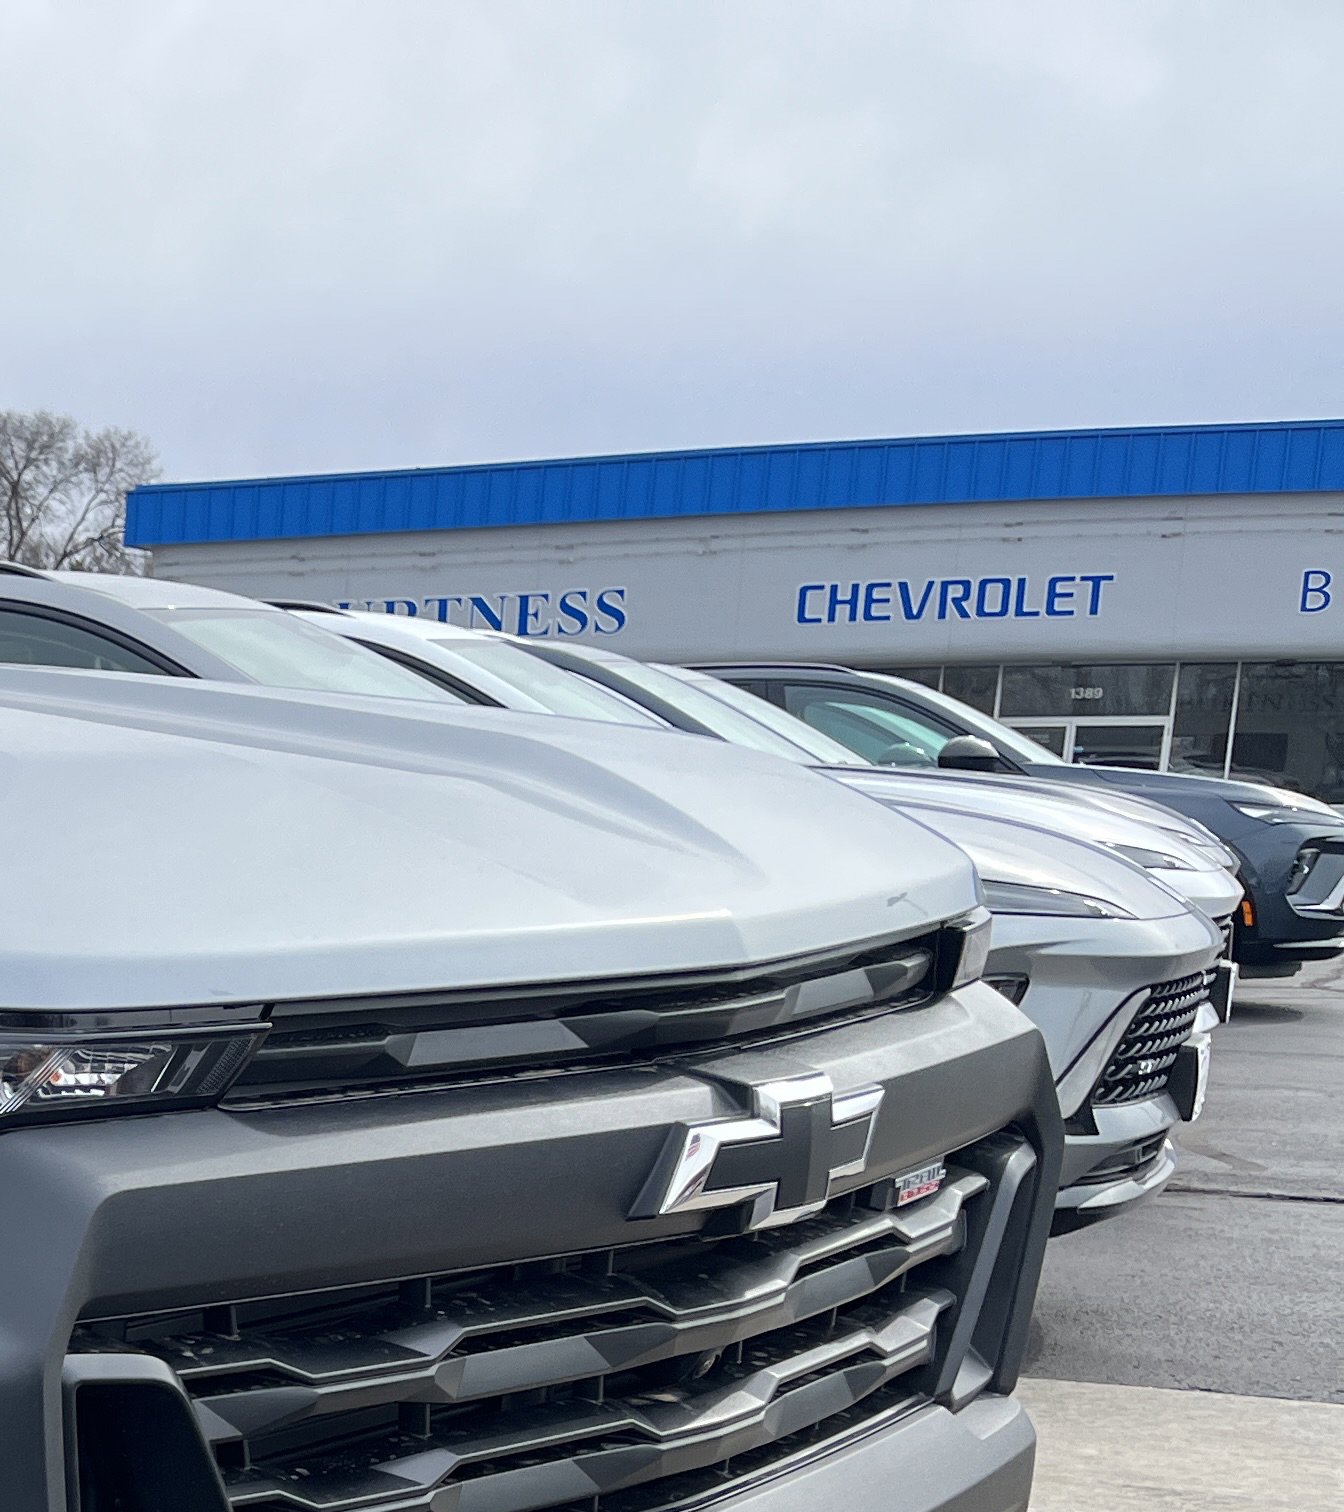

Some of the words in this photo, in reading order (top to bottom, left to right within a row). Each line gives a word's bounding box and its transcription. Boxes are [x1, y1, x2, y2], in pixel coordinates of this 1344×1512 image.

[337, 588, 626, 637] TNESS
[796, 574, 1115, 625] CHEVROLET
[1069, 687, 1104, 700] 1389
